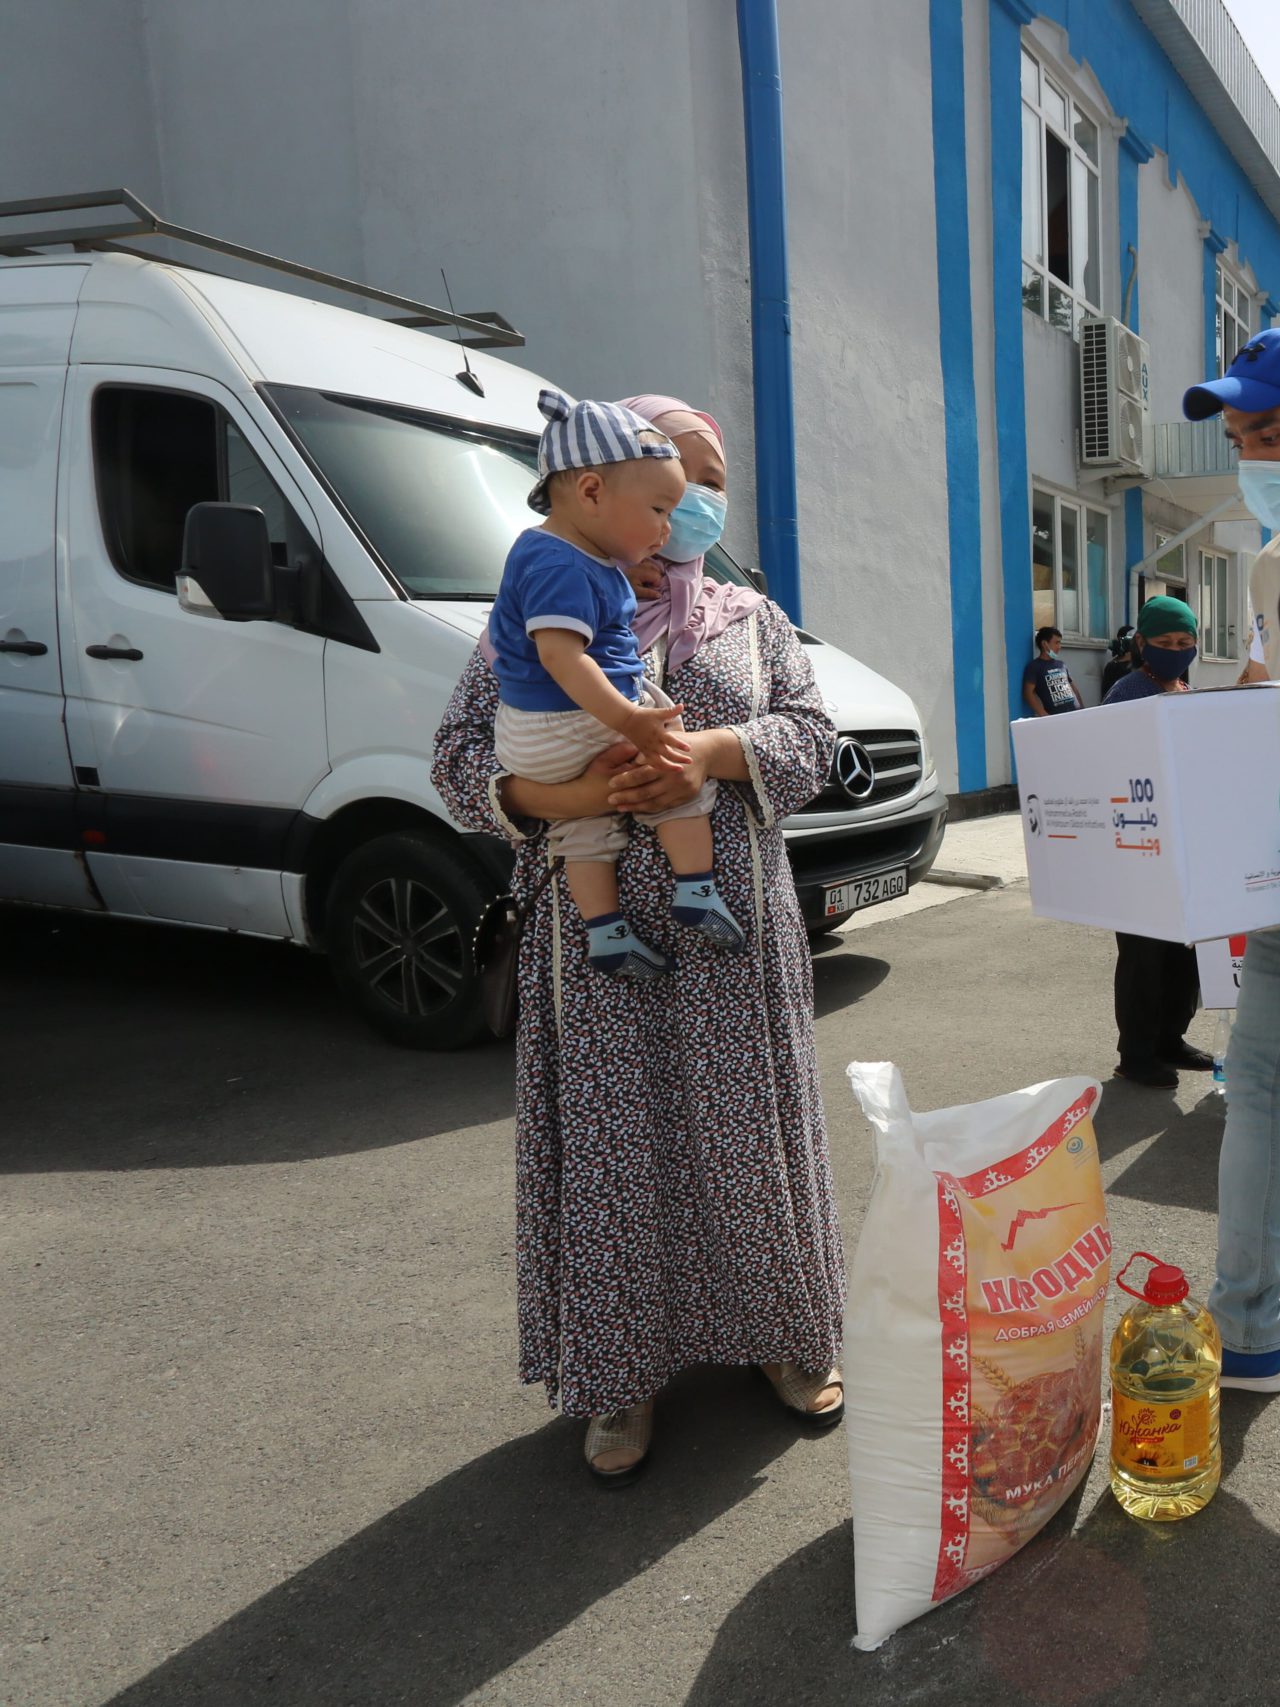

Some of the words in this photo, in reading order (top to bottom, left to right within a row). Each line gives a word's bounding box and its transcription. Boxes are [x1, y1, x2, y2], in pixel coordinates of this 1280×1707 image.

[1129, 778, 1154, 803] 100
[1112, 807, 1158, 829] مليون
[1115, 832, 1161, 857] وجبة
[830, 888, 843, 904] 01
[854, 879, 880, 906] 732
[882, 875, 904, 897] AGQ
[994, 1320, 1056, 1342] ДОБРАЯ
[1119, 1414, 1182, 1446] Южанка
[1005, 1474, 1053, 1500] МУКА
